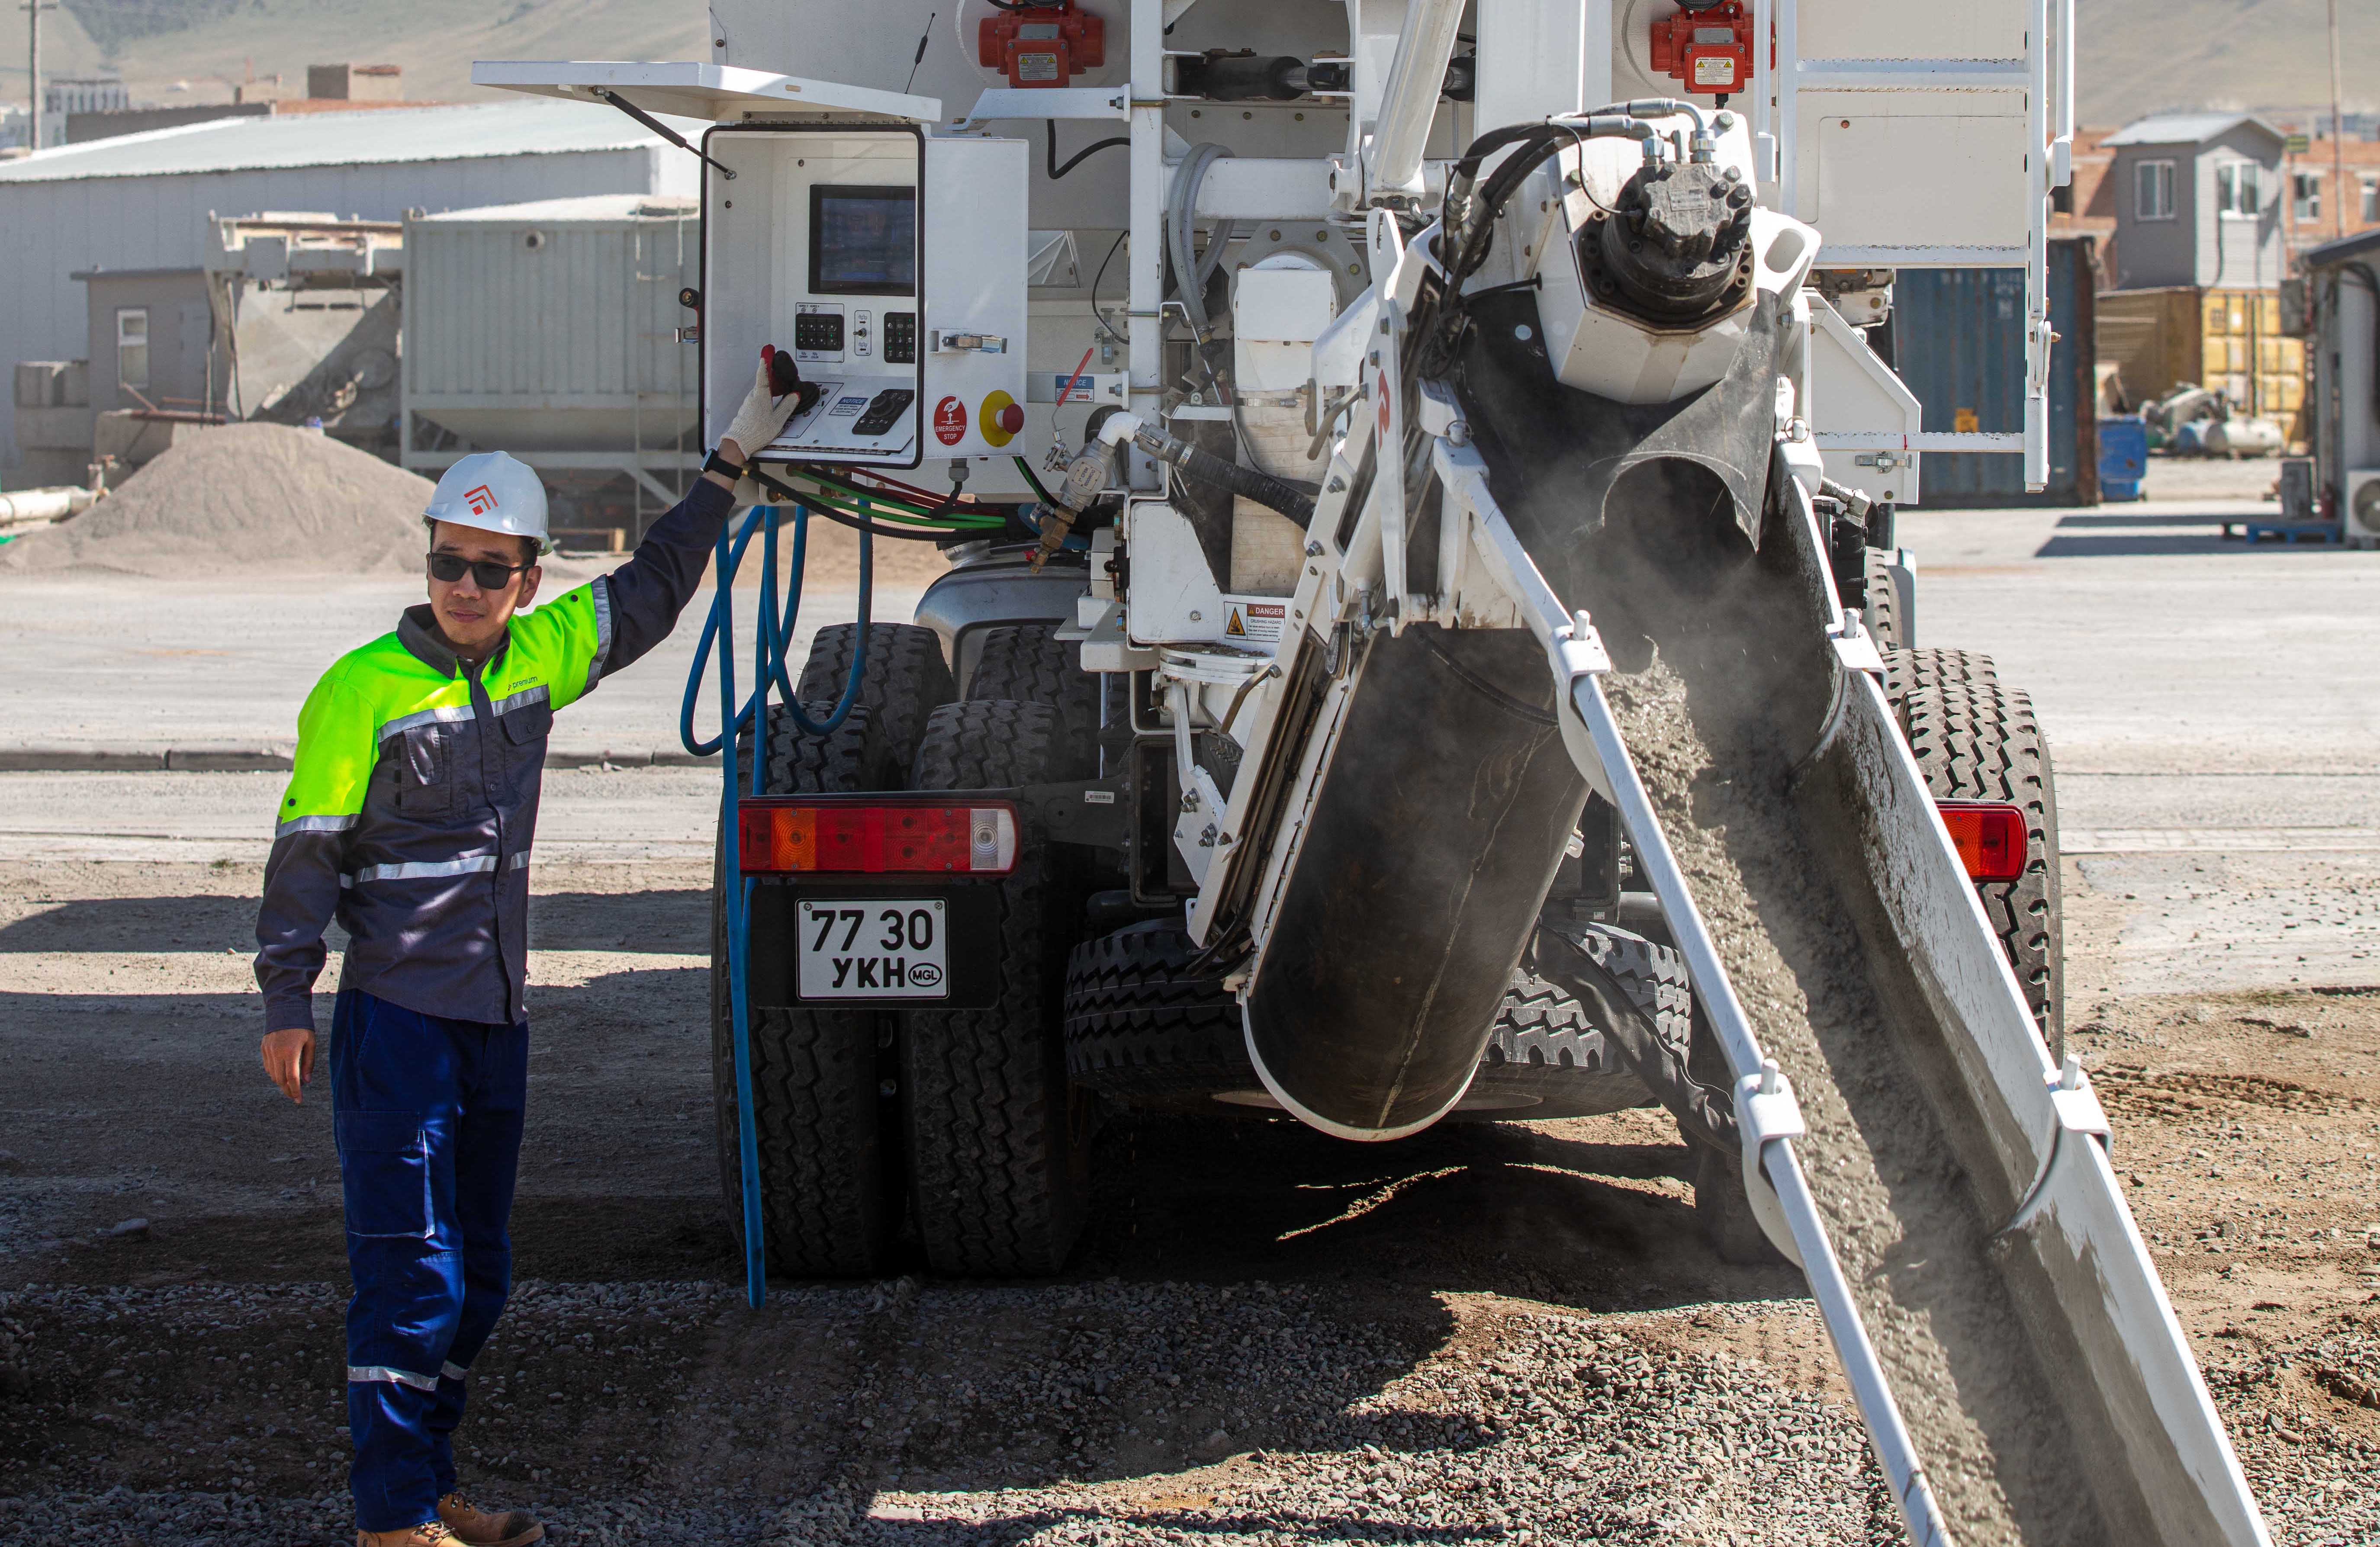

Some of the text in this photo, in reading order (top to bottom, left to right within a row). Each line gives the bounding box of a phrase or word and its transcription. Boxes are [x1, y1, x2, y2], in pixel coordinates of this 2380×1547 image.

[512, 676, 537, 689] premium
[811, 909, 933, 952] 77 30
[832, 957, 905, 988] УКН
[913, 969, 937, 981] MGL
